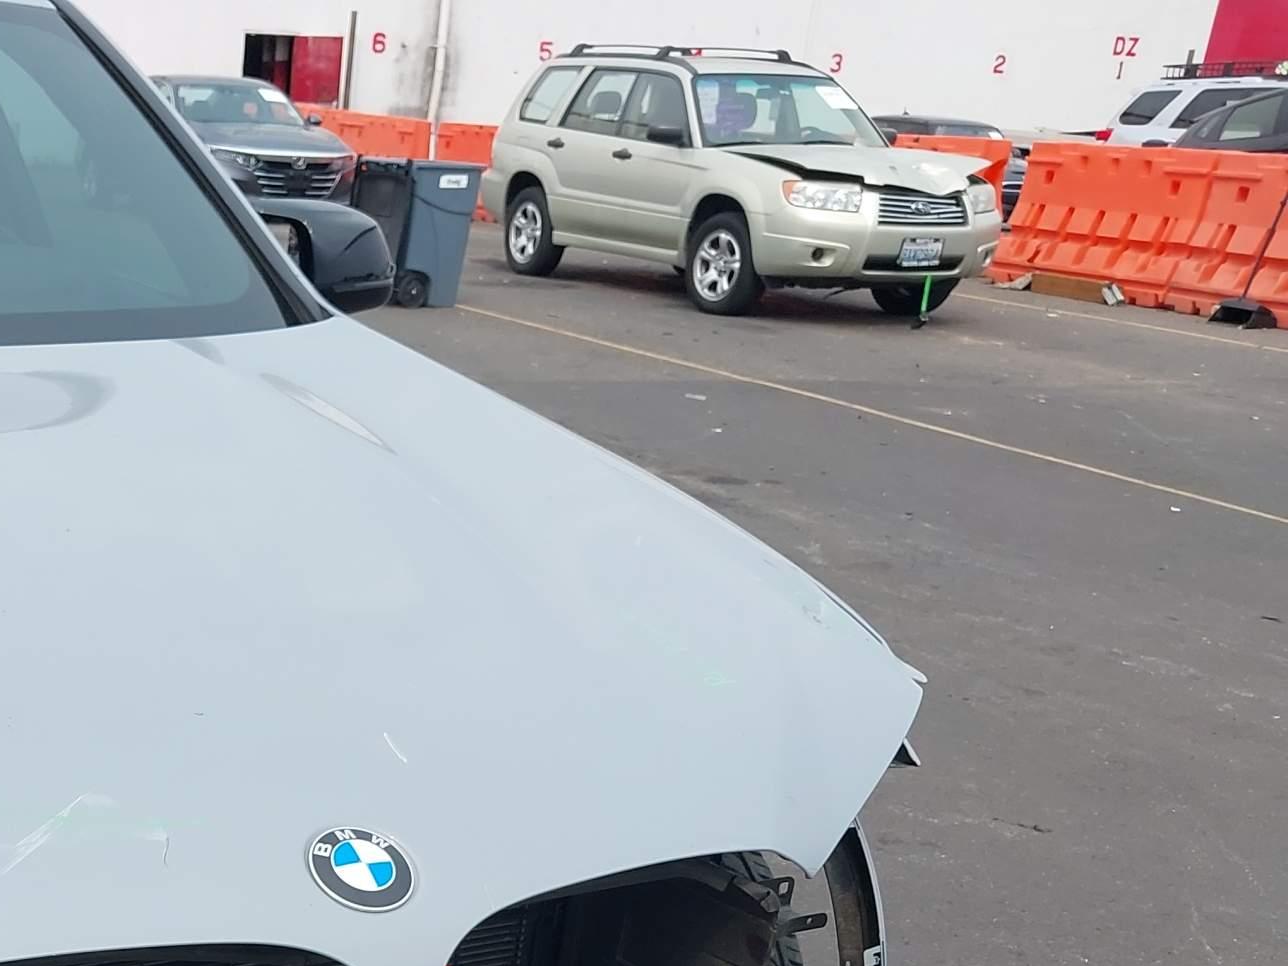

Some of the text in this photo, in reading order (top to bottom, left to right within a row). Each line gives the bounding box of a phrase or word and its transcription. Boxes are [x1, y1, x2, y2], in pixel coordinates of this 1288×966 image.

[371, 32, 387, 53] 6
[539, 41, 553, 61] 5
[1112, 36, 1140, 57] DZ
[829, 54, 843, 73] 3
[992, 55, 1006, 74] 2
[313, 829, 390, 858] BMW
